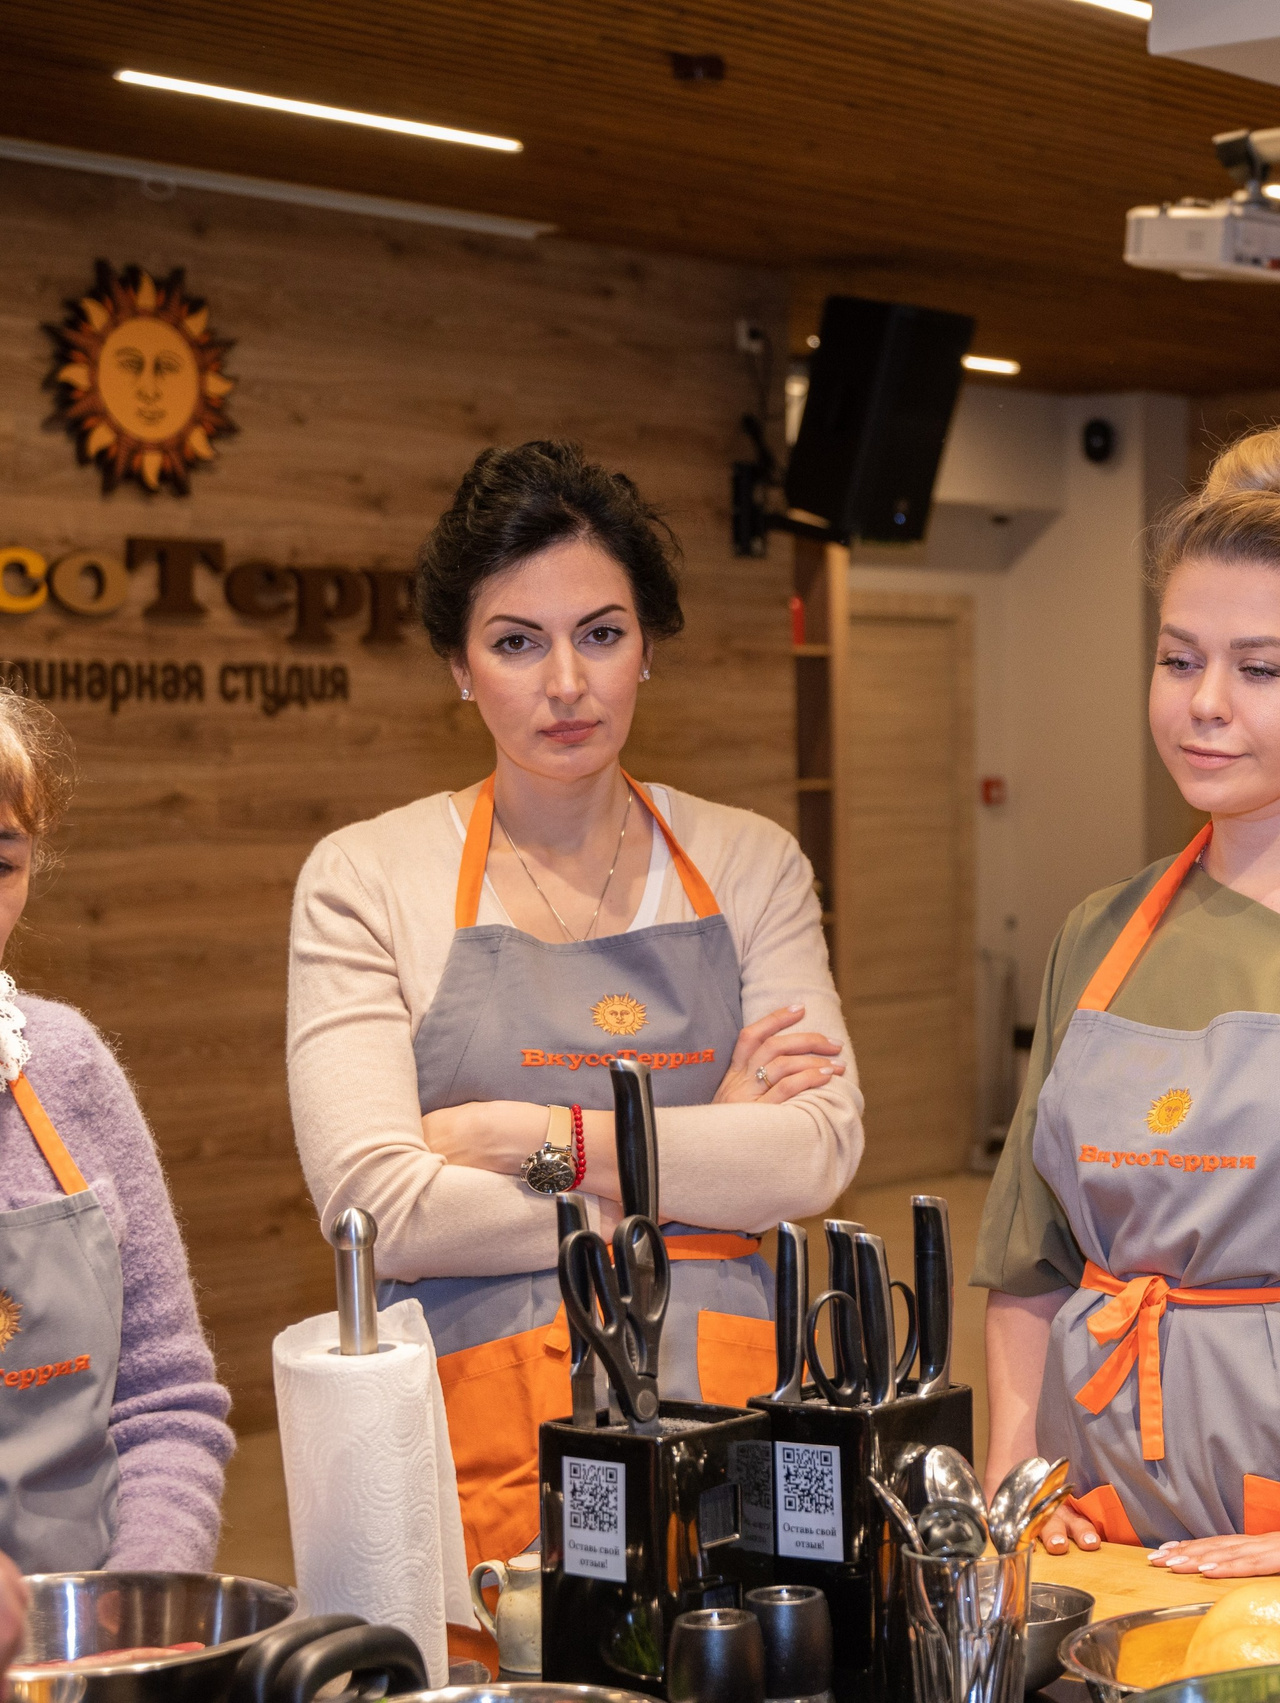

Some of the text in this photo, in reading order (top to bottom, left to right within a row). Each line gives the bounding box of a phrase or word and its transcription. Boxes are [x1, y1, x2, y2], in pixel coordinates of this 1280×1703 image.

[0, 658, 349, 717] линарная студия
[520, 1049, 715, 1071] ВкусоТеррия
[1078, 1144, 1257, 1173] ВкусоТеррия
[0, 1353, 91, 1391] еррия
[782, 1522, 814, 1535] Оставь
[815, 1526, 837, 1537] свой
[568, 1538, 620, 1556] Оставь свой
[795, 1540, 825, 1551] отзыв!
[580, 1558, 608, 1569] отзыв!
